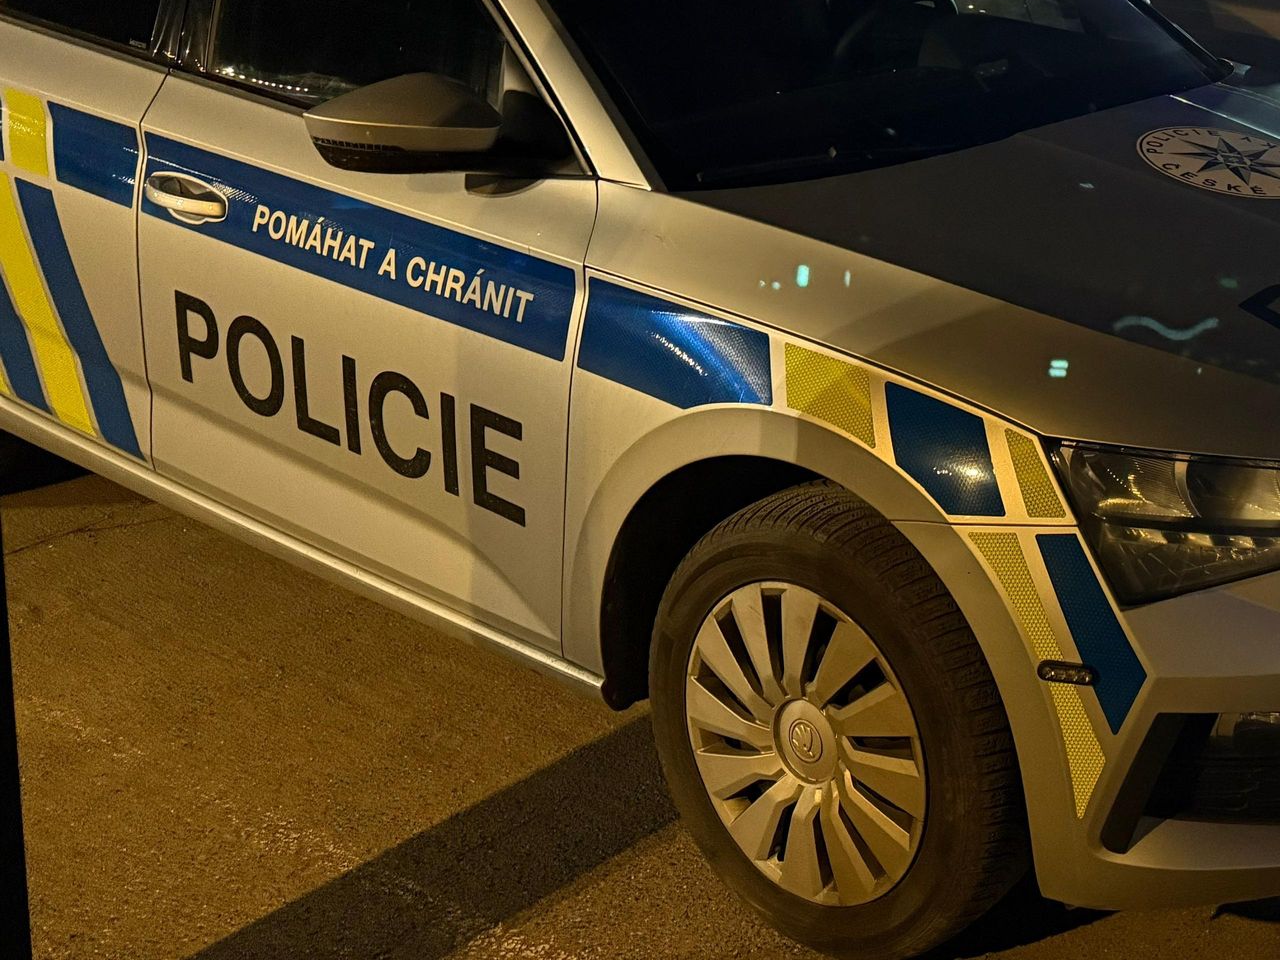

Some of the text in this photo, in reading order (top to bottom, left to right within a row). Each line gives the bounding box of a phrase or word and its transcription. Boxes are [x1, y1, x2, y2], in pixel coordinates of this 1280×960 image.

[1146, 129, 1219, 155] POLICIE
[1162, 162, 1266, 195] ČESKÉ
[252, 204, 534, 324] POMÁHAT A CHRÁNIT
[174, 290, 526, 527] POLICIE
